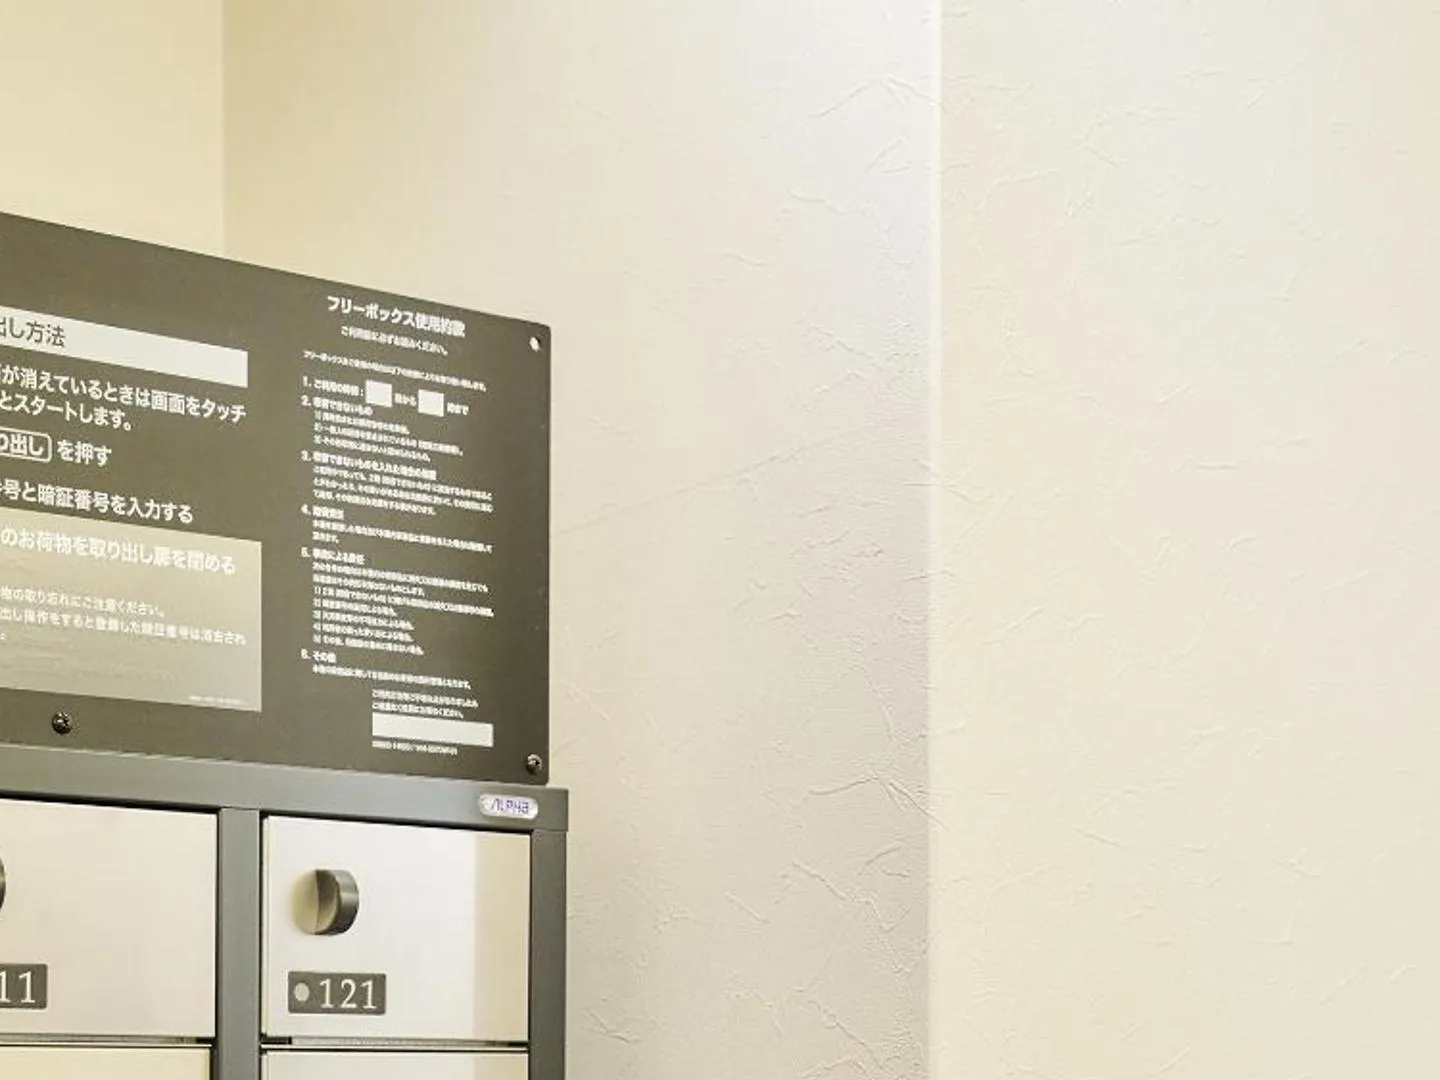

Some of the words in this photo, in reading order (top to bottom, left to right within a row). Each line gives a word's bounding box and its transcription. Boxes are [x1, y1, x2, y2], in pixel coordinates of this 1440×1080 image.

[57, 440, 112, 467] を押す
[319, 978, 377, 1010] 121
